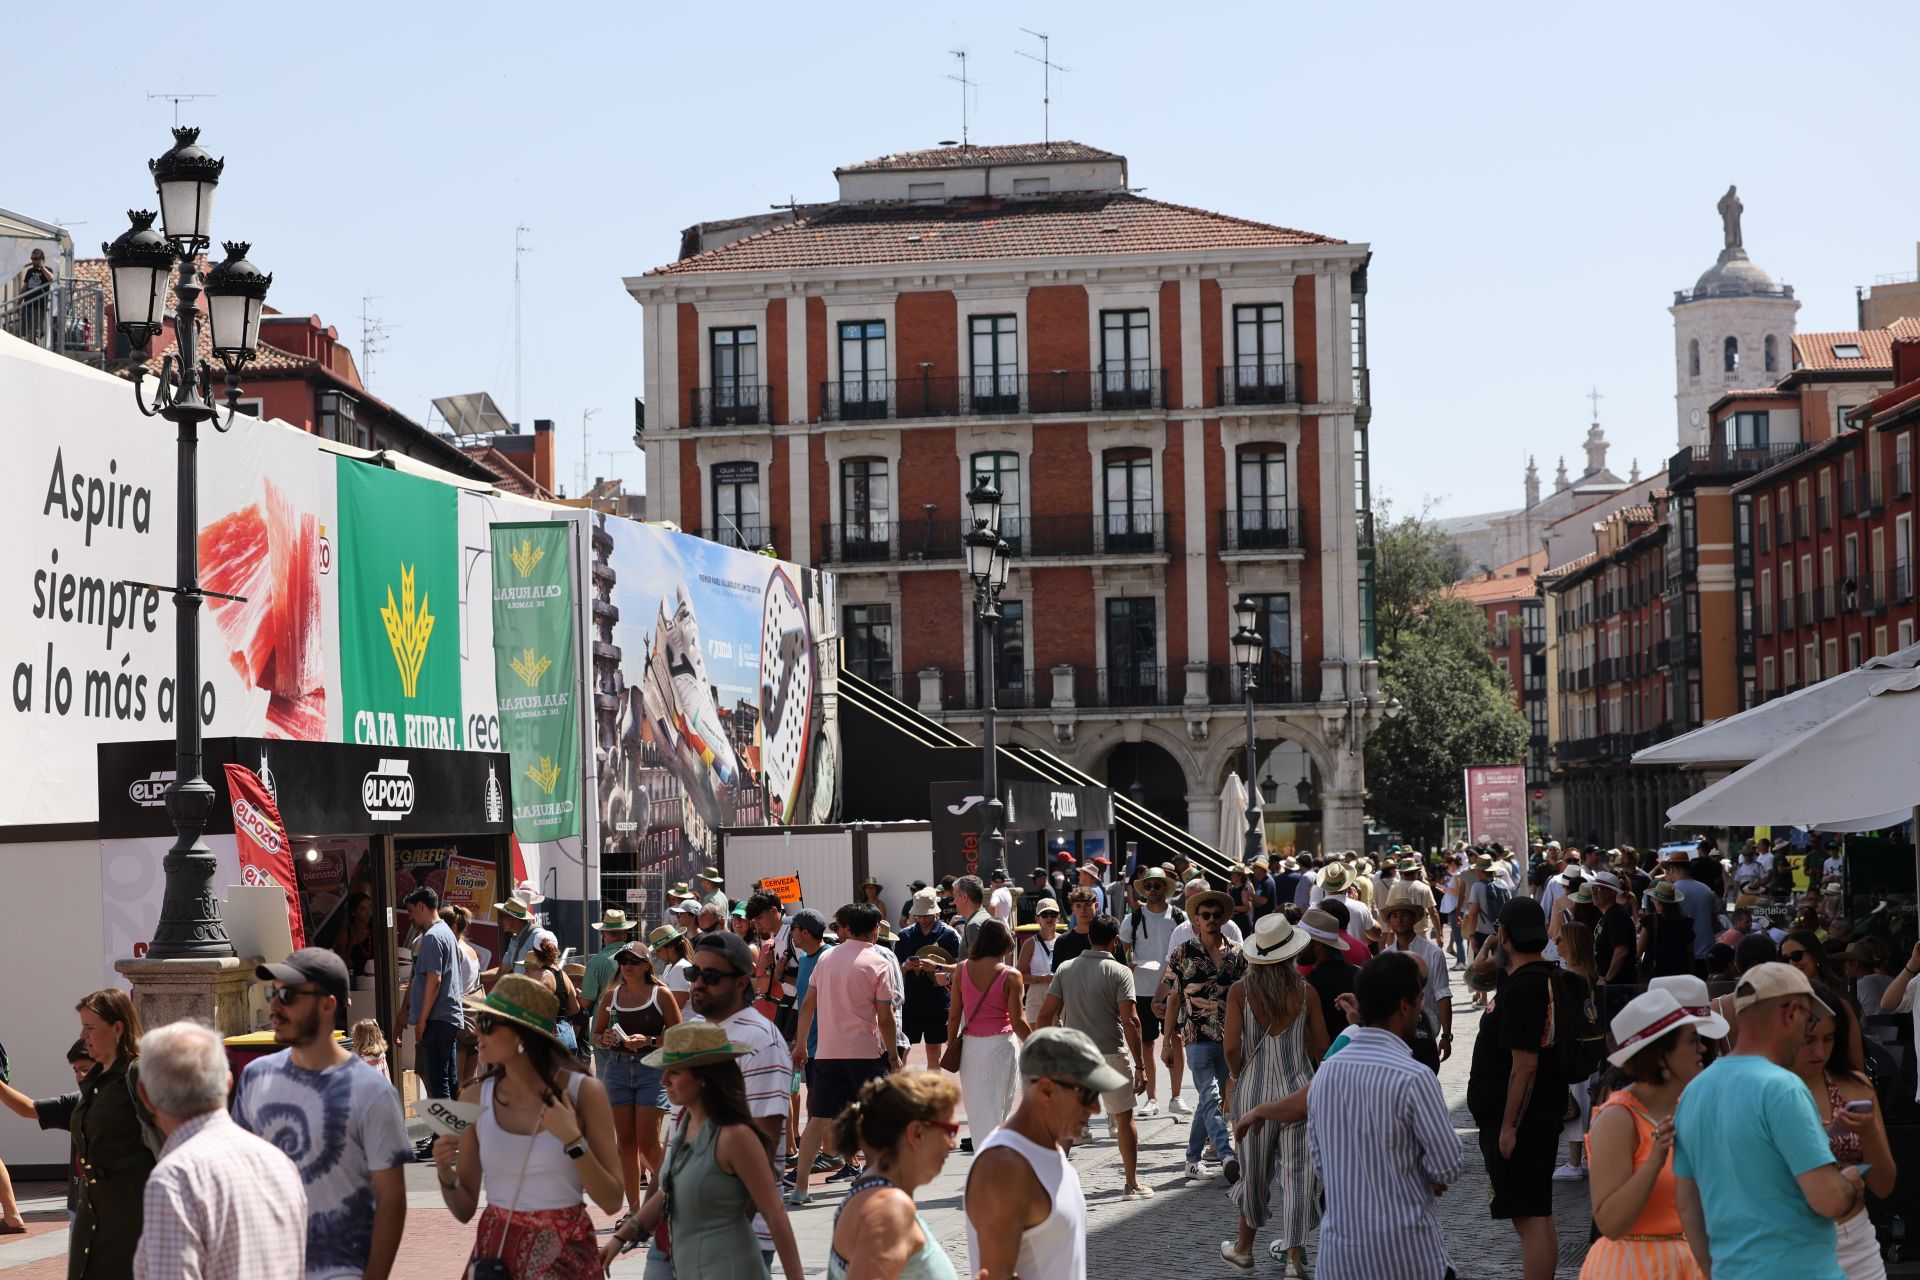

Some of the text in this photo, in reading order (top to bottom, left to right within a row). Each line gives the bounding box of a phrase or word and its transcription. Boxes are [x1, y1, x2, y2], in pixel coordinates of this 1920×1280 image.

[44, 445, 151, 547] Aspira
[32, 548, 160, 650] siempre
[12, 642, 216, 726] a lo más ao
[354, 710, 460, 751] CAJA RURAL
[468, 713, 499, 750] rec
[960, 831, 978, 876] adel
[764, 877, 795, 887] CERVEZA
